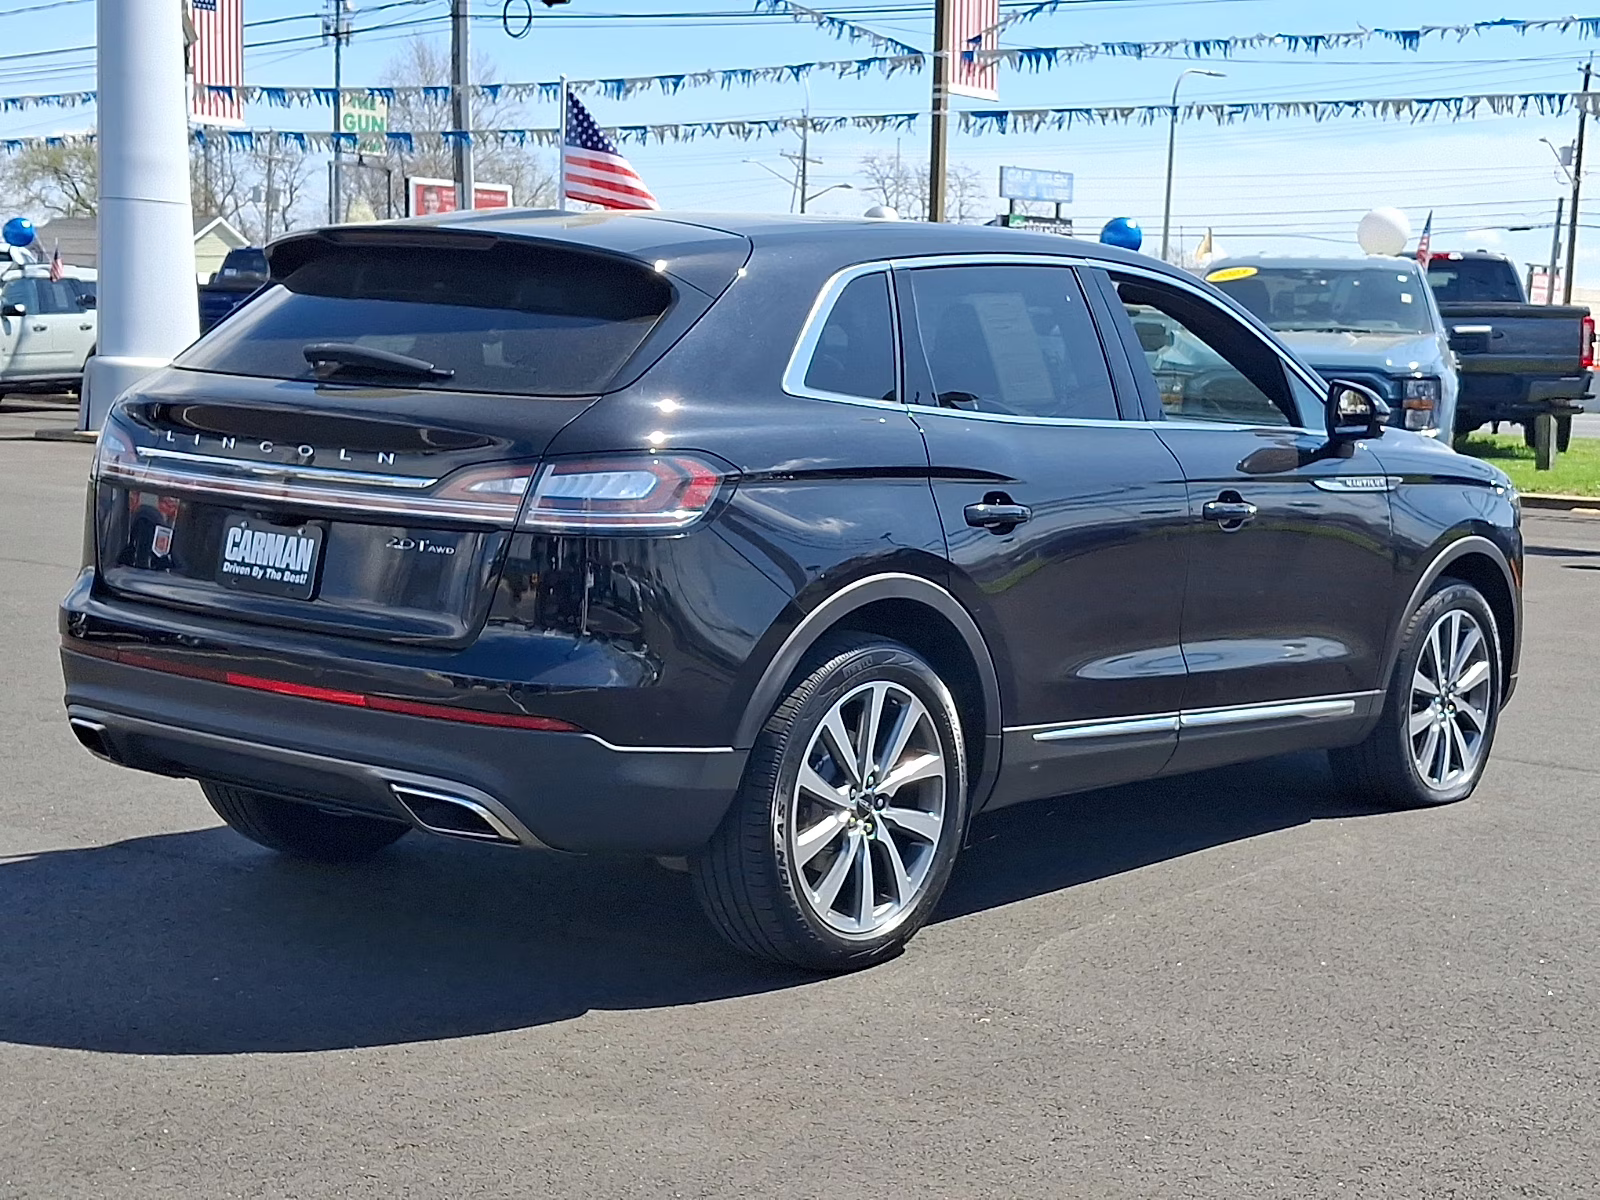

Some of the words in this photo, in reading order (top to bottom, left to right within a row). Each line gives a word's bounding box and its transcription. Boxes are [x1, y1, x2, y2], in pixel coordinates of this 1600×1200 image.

[342, 112, 385, 134] GUN
[1006, 168, 1032, 183] CAR
[1035, 172, 1069, 188] WASH
[166, 430, 395, 466] LINCOLN
[224, 526, 315, 573] CARMAN
[427, 545, 455, 555] AWD
[222, 561, 251, 576] Driven
[251, 566, 265, 580] By
[265, 568, 282, 581] The
[282, 571, 308, 585] Best!
